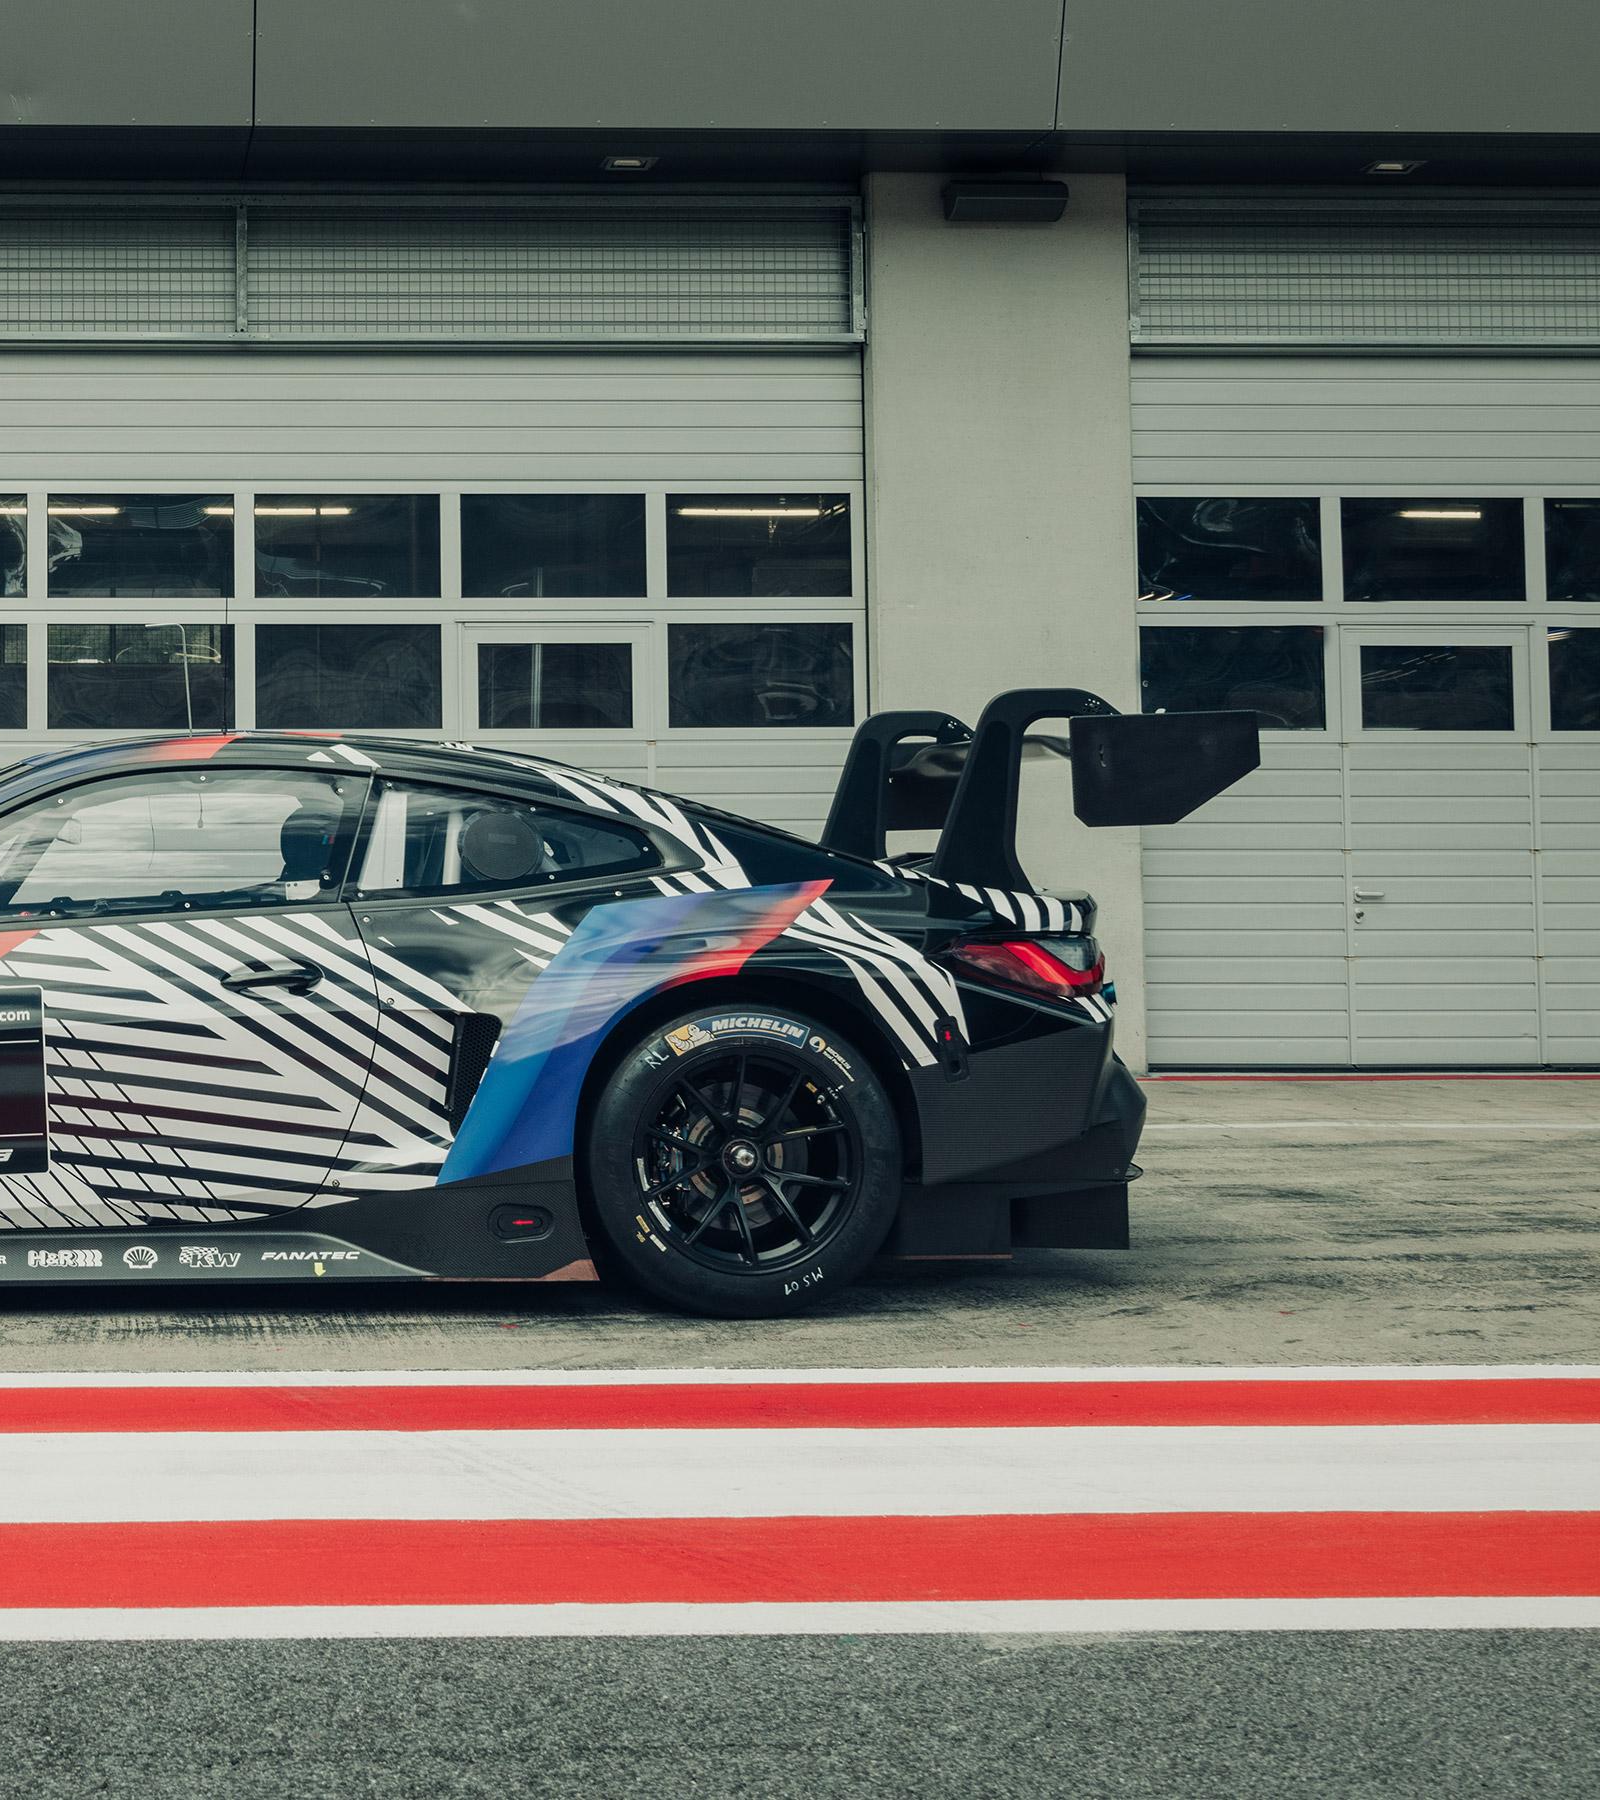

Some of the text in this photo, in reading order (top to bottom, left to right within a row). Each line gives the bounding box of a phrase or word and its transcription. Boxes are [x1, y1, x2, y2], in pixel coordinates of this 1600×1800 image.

[711, 1016, 805, 1039] MICHELIN
[644, 1050, 670, 1069] RL
[190, 1252, 241, 1268] KW
[261, 1251, 360, 1261] FANATEC
